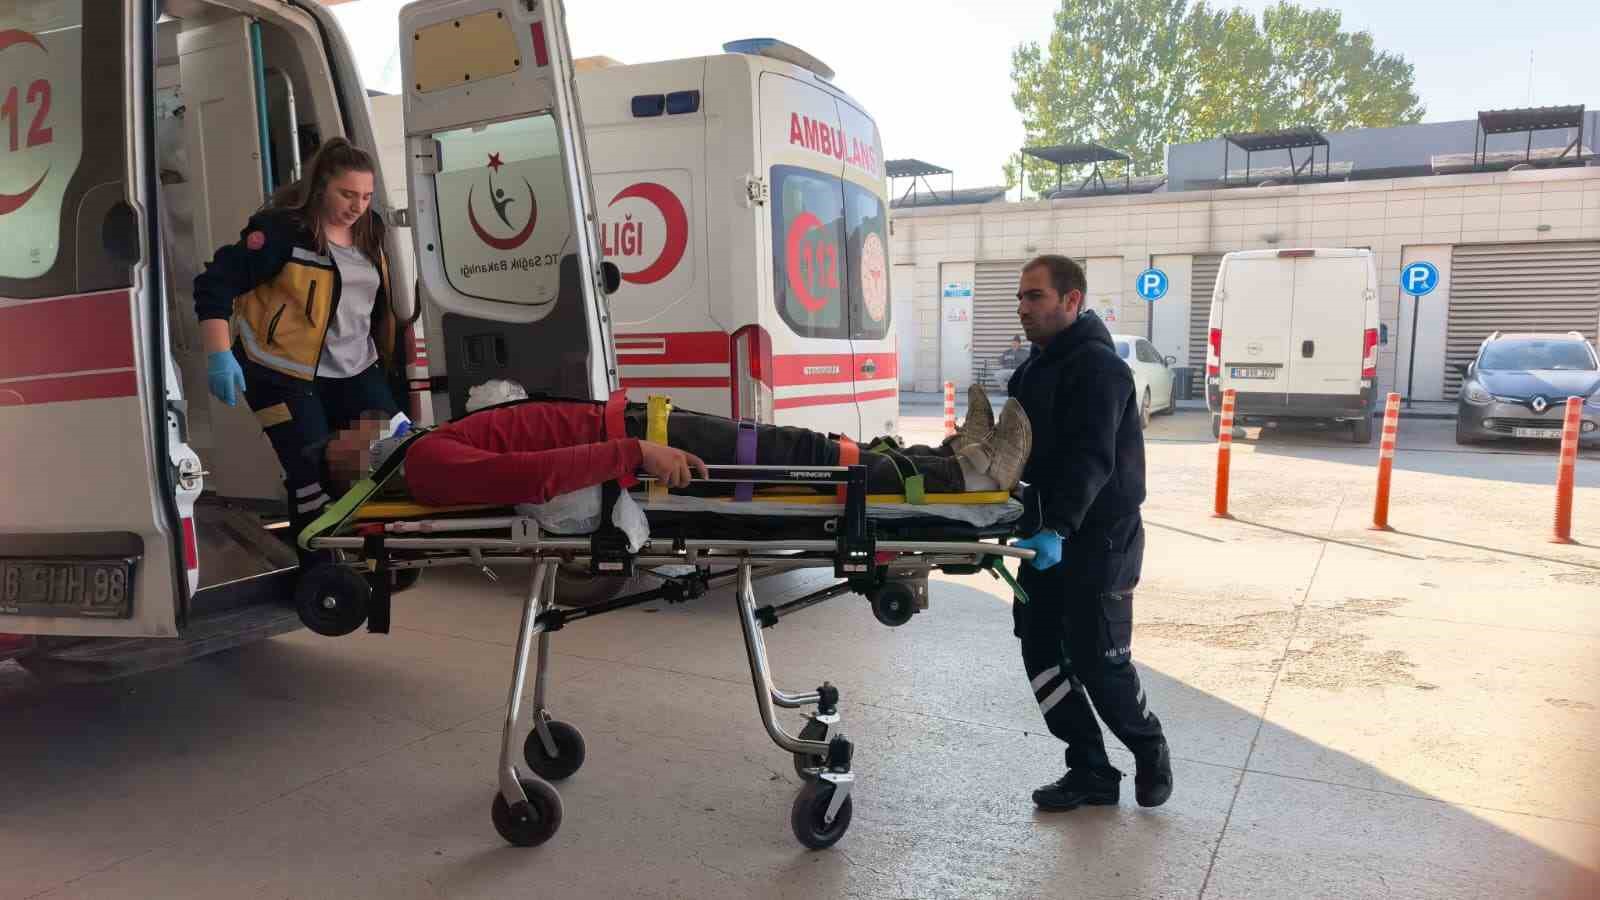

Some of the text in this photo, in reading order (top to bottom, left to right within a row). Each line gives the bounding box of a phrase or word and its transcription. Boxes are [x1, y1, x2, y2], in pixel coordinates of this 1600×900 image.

[803, 240, 839, 289] 112
[1410, 267, 1429, 290] P
[1144, 274, 1160, 295] P
[95, 566, 126, 602] 98
